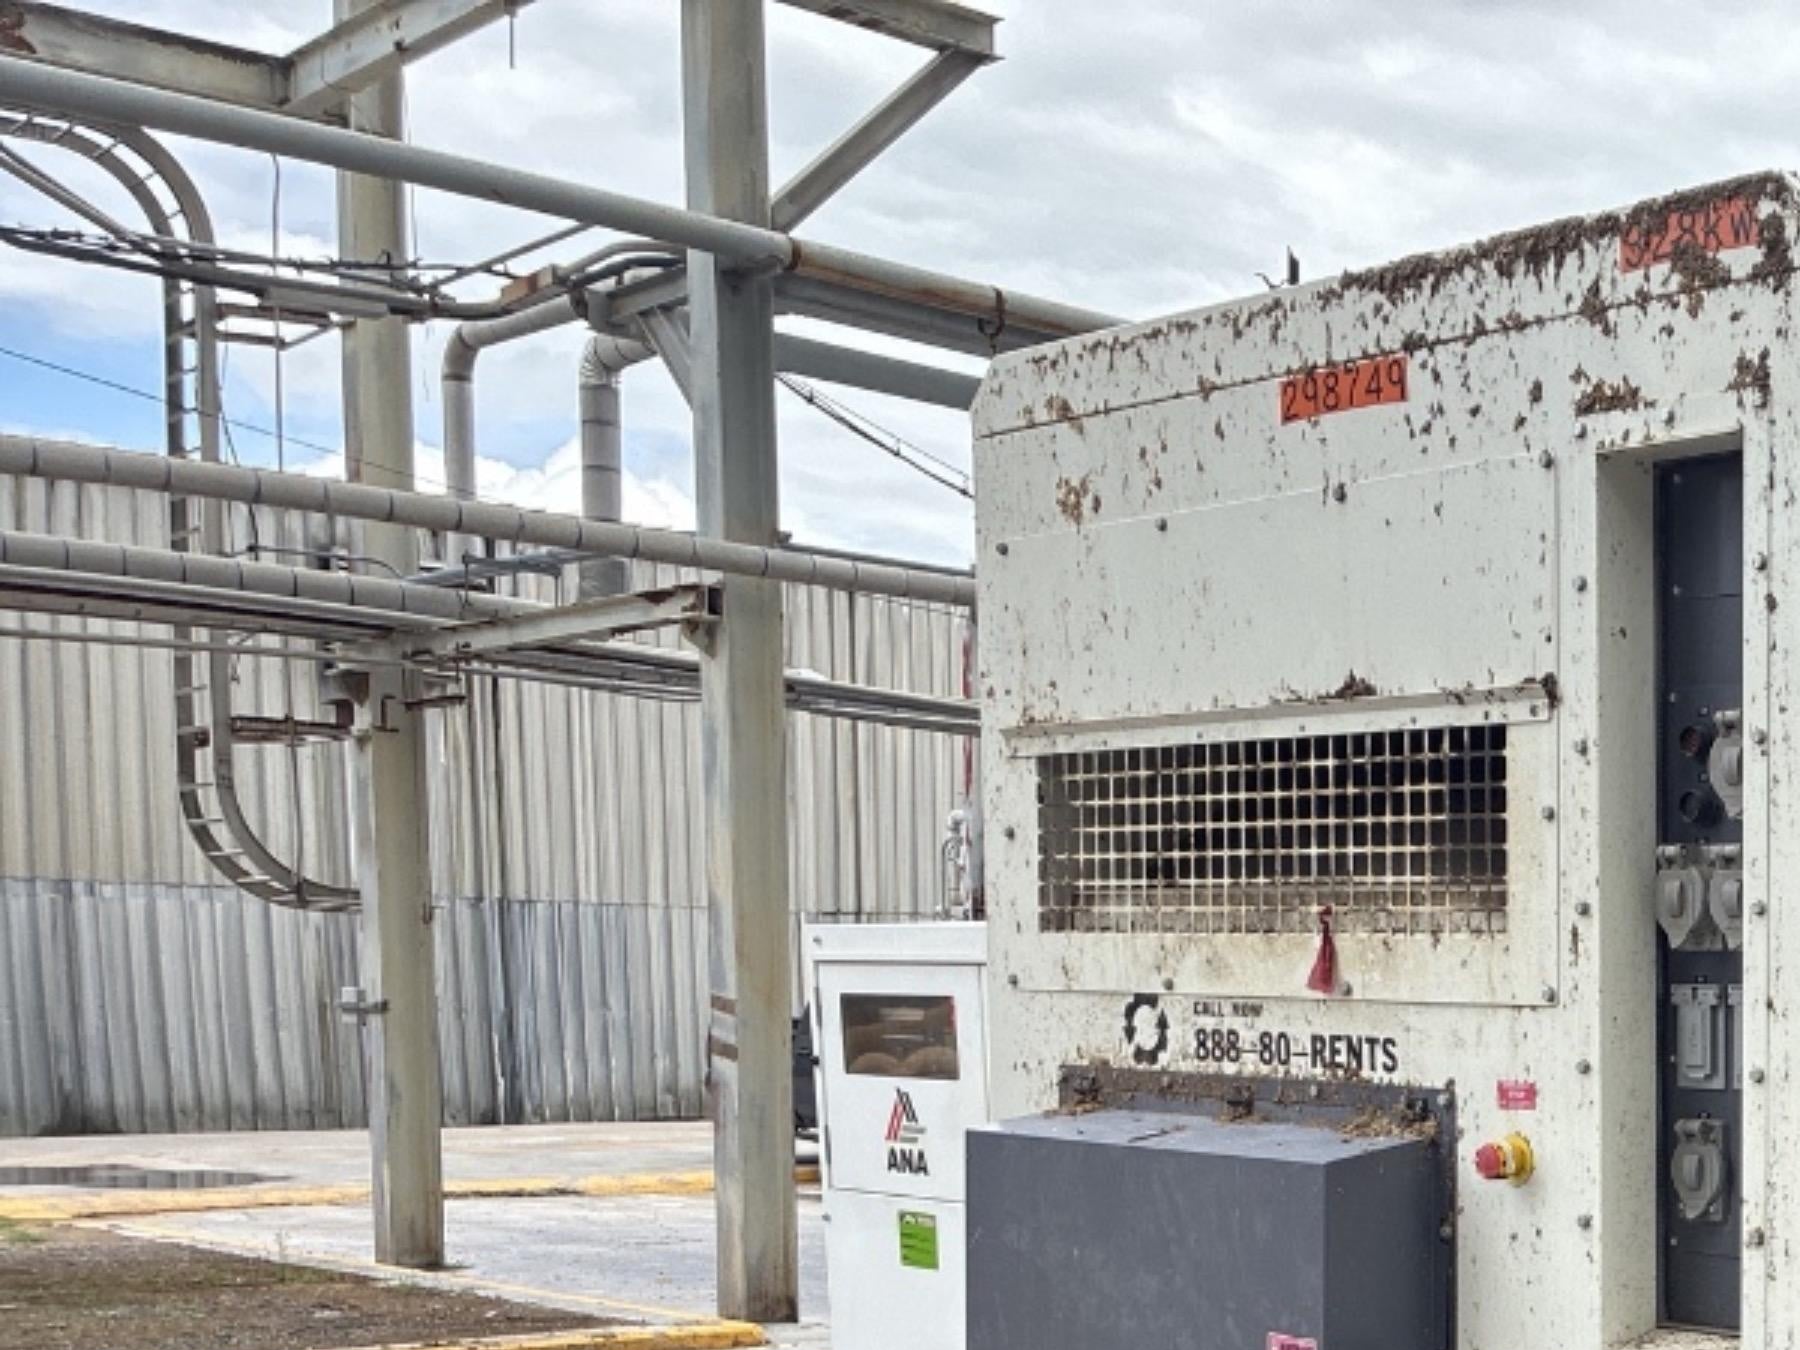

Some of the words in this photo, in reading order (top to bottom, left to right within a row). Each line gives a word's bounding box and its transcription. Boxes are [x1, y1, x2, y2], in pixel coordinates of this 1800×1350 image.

[1282, 358, 1406, 422] 298749
[1193, 1001, 1225, 1018] CALL
[1231, 1002, 1263, 1017] NOW
[1194, 1028, 1399, 1074] 888-80-RENTS
[887, 1146, 929, 1175] ANA
